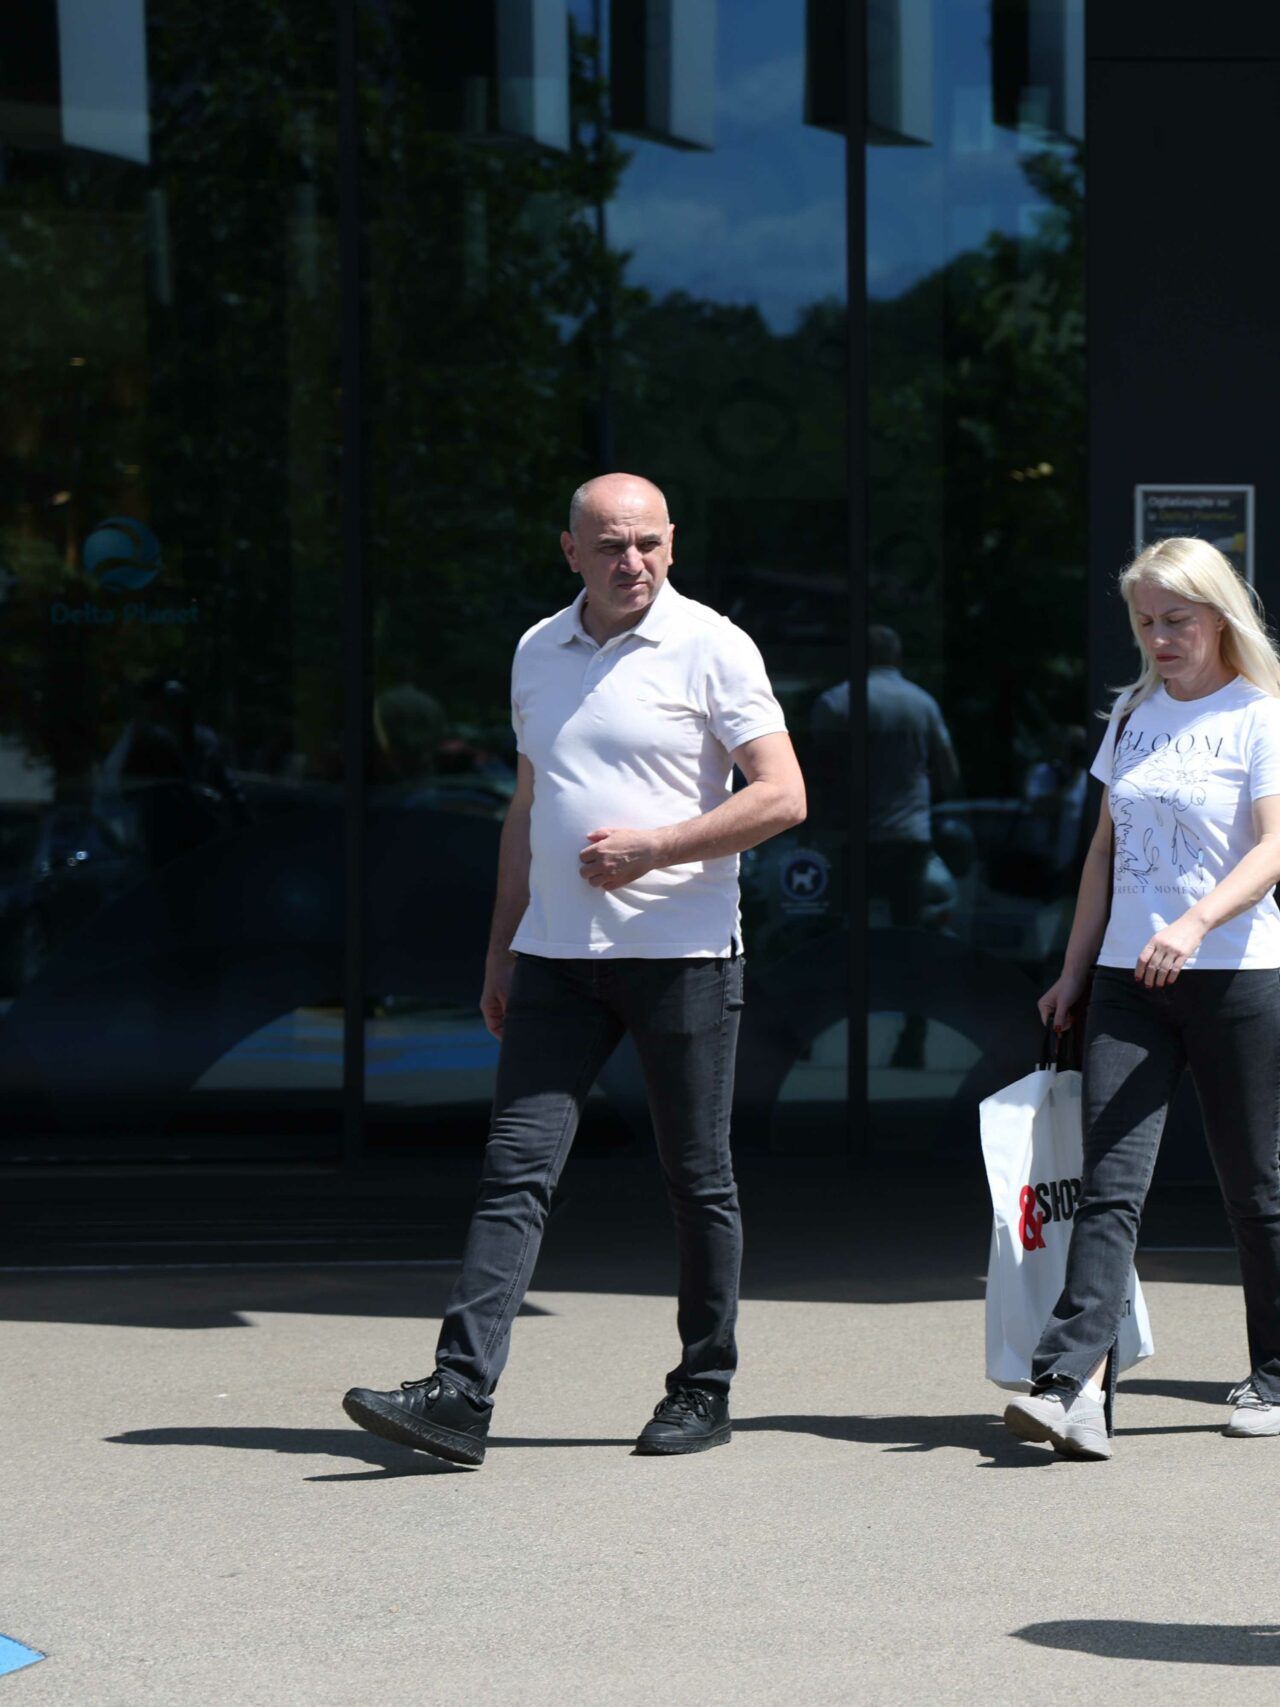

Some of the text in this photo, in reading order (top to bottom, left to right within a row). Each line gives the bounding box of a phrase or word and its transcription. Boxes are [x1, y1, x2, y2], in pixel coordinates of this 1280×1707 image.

[51, 602, 200, 624] Delta Planet
[1119, 730, 1223, 758] BLOOM
[1154, 886, 1207, 896] MOMENT
